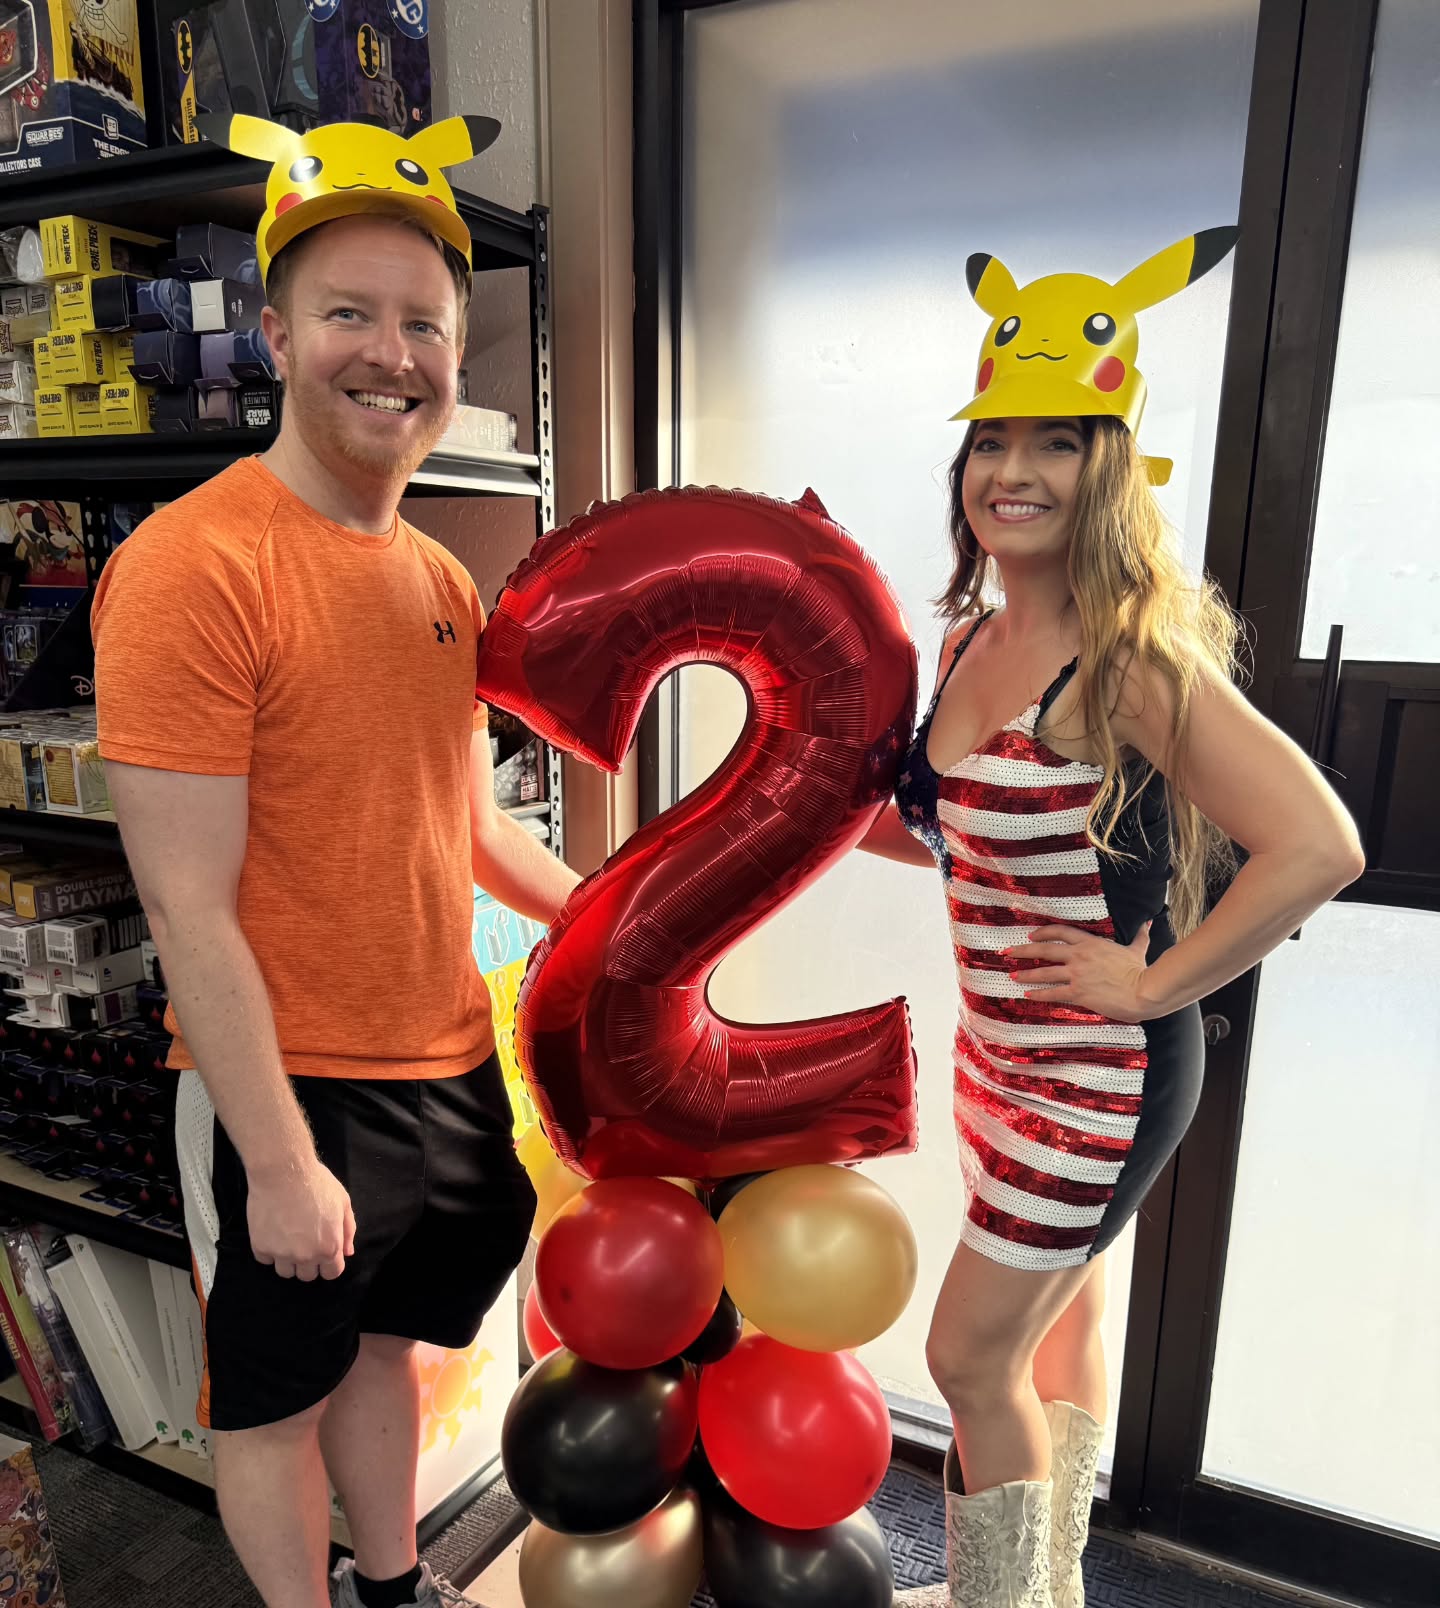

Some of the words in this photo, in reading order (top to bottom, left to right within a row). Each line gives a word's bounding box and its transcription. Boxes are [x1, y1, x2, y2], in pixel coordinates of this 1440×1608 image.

[92, 138, 110, 152] THE
[0, 159, 28, 173] OLLECTORS
[27, 157, 42, 169] CASE
[61, 224, 70, 244] PIECE
[89, 223, 98, 249] PIECE
[88, 249, 100, 272] ONE
[246, 409, 271, 418] WARS
[247, 417, 272, 426] STAR
[57, 883, 136, 913] PLAYMA
